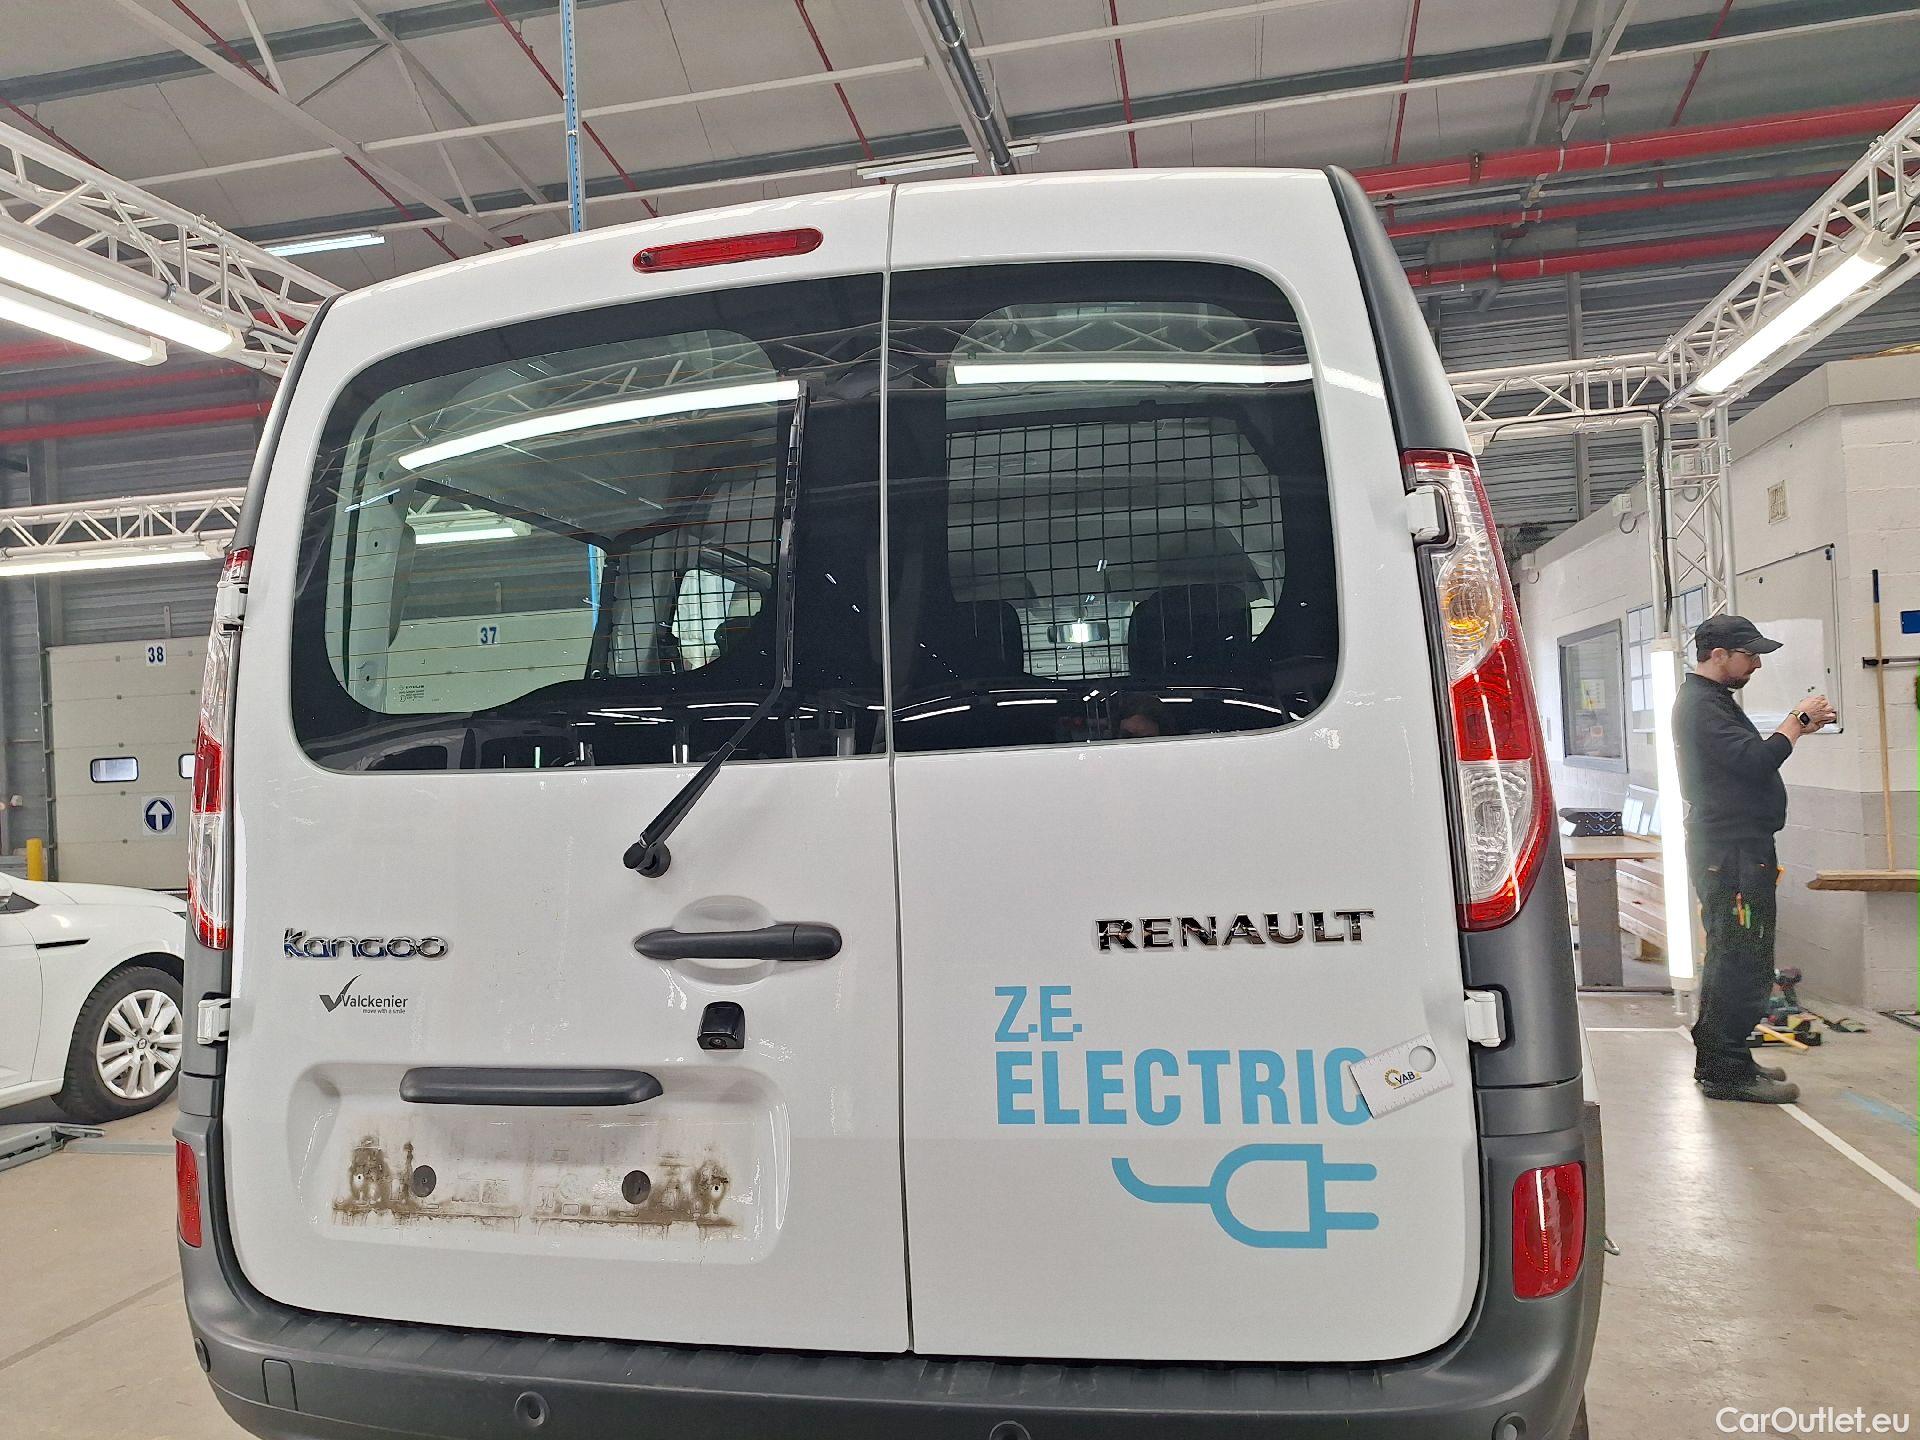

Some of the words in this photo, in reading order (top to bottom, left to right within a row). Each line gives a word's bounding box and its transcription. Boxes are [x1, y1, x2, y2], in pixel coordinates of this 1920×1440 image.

[480, 626, 497, 644] 37
[147, 646, 164, 663] 38
[1094, 909, 1375, 951] RENAULT
[283, 928, 449, 959] Kangoo
[341, 994, 409, 1008] Valckenier
[995, 985, 1082, 1042] Z.E.
[995, 1048, 1373, 1126] ELECTRIC
[1394, 1071, 1416, 1085] VAB
